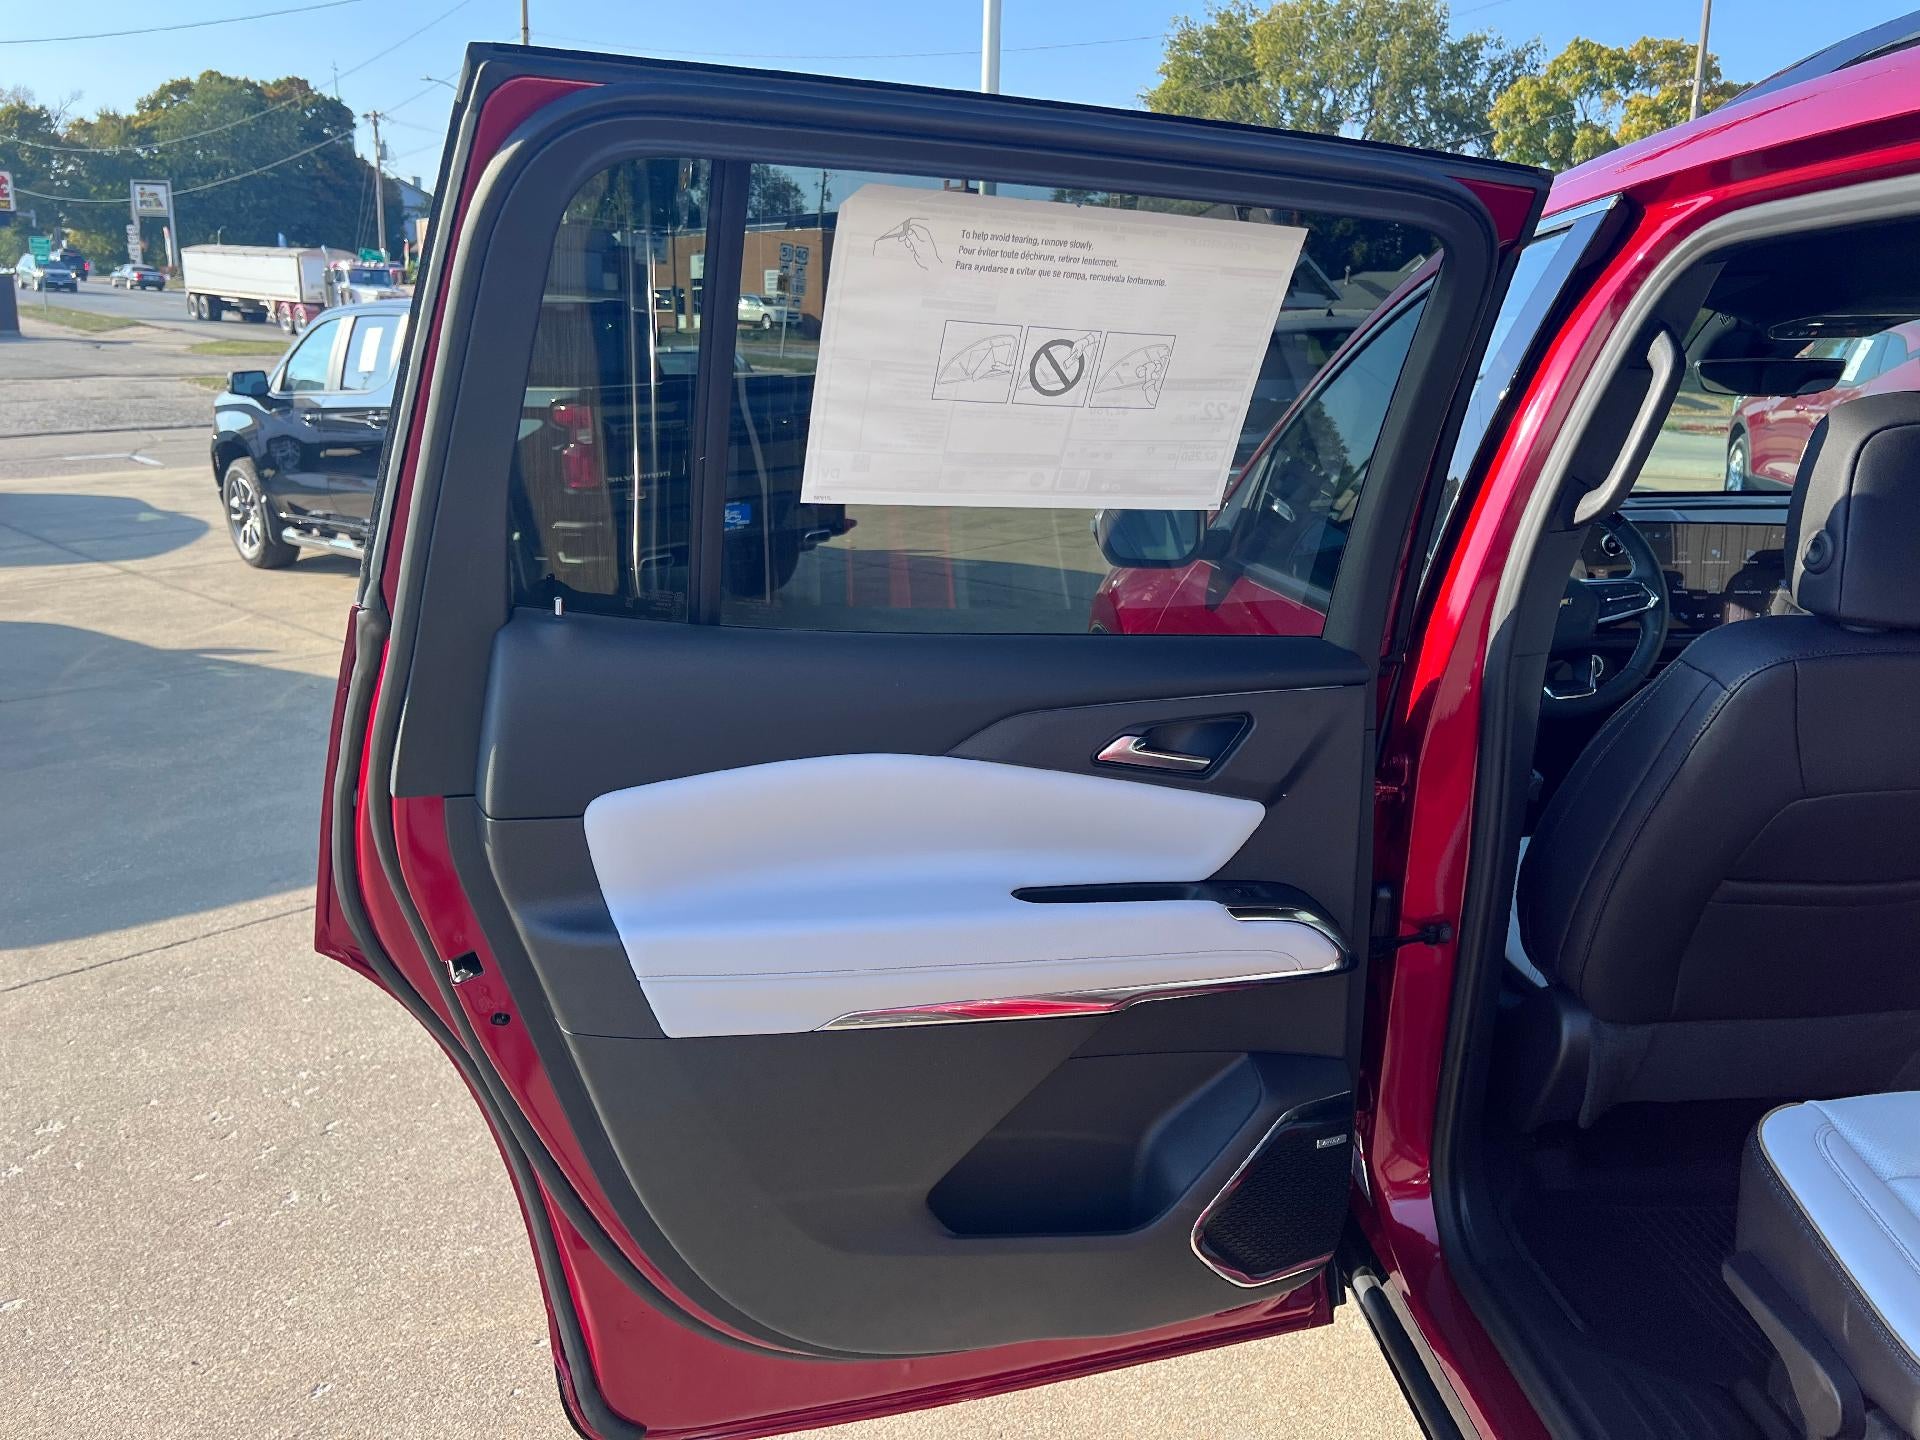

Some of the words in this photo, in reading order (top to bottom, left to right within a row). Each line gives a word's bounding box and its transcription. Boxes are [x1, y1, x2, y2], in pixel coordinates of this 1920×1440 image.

[961, 229, 971, 239] To
[972, 230, 989, 241] help
[990, 233, 1011, 243] avoid
[1011, 234, 1040, 247] tearing,
[1041, 239, 1068, 248] remove
[958, 245, 977, 255] Pour
[977, 247, 999, 258] éviter
[1000, 250, 1019, 260] toute
[955, 260, 972, 271] Para
[973, 264, 1009, 274] ayudarse
[1009, 267, 1015, 275] a
[1016, 267, 1036, 277] evitar
[1038, 270, 1051, 278] que
[1052, 270, 1062, 278] se
